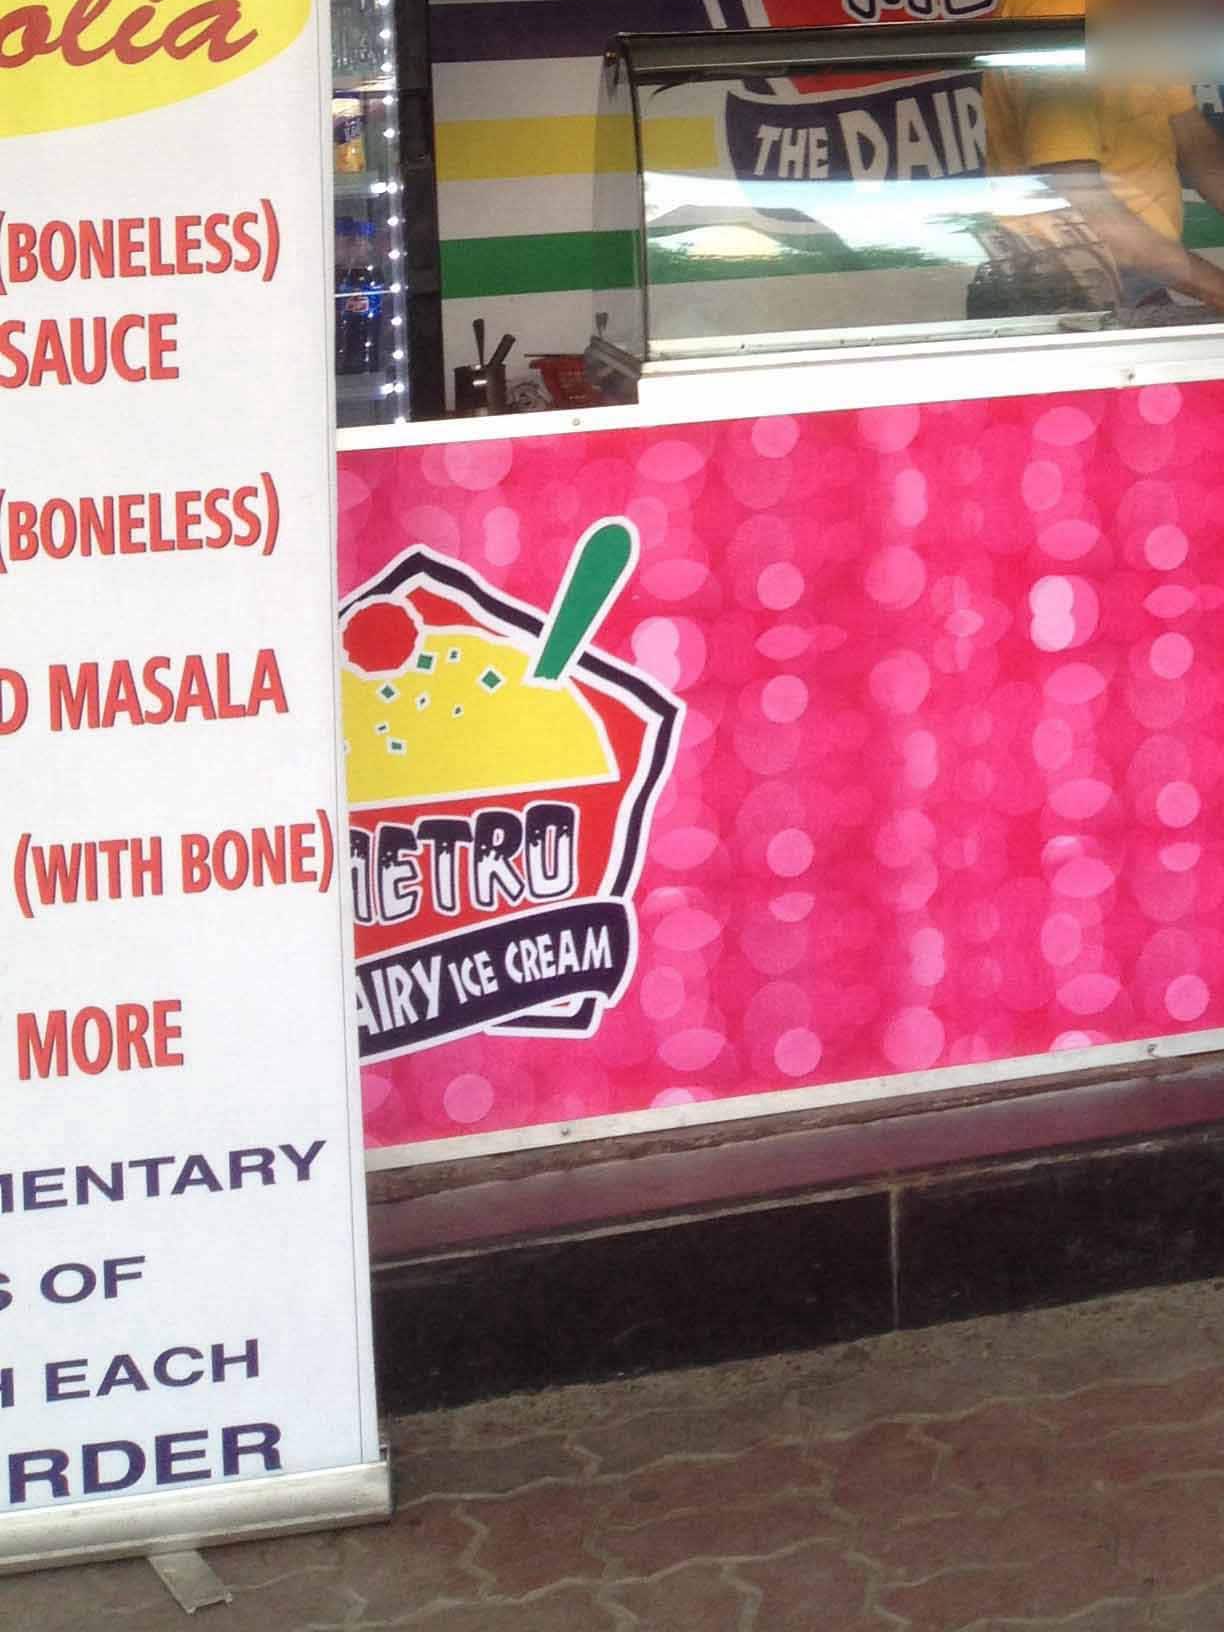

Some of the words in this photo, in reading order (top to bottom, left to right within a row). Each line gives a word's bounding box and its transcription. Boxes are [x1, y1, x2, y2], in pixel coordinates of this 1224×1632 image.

[753, 124, 831, 179] THE
[839, 85, 987, 191] DAIR
[0, 313, 180, 389] SAUCE
[49, 648, 289, 732] MASALA
[13, 832, 164, 919] (WITH
[181, 808, 335, 894] BONE)
[448, 950, 499, 1005] ICE
[505, 925, 614, 984] CREAM
[17, 999, 184, 1081] MORE
[40, 1255, 146, 1305] OF
[45, 1338, 260, 1403] EACH
[8, 1422, 283, 1504] RDER
